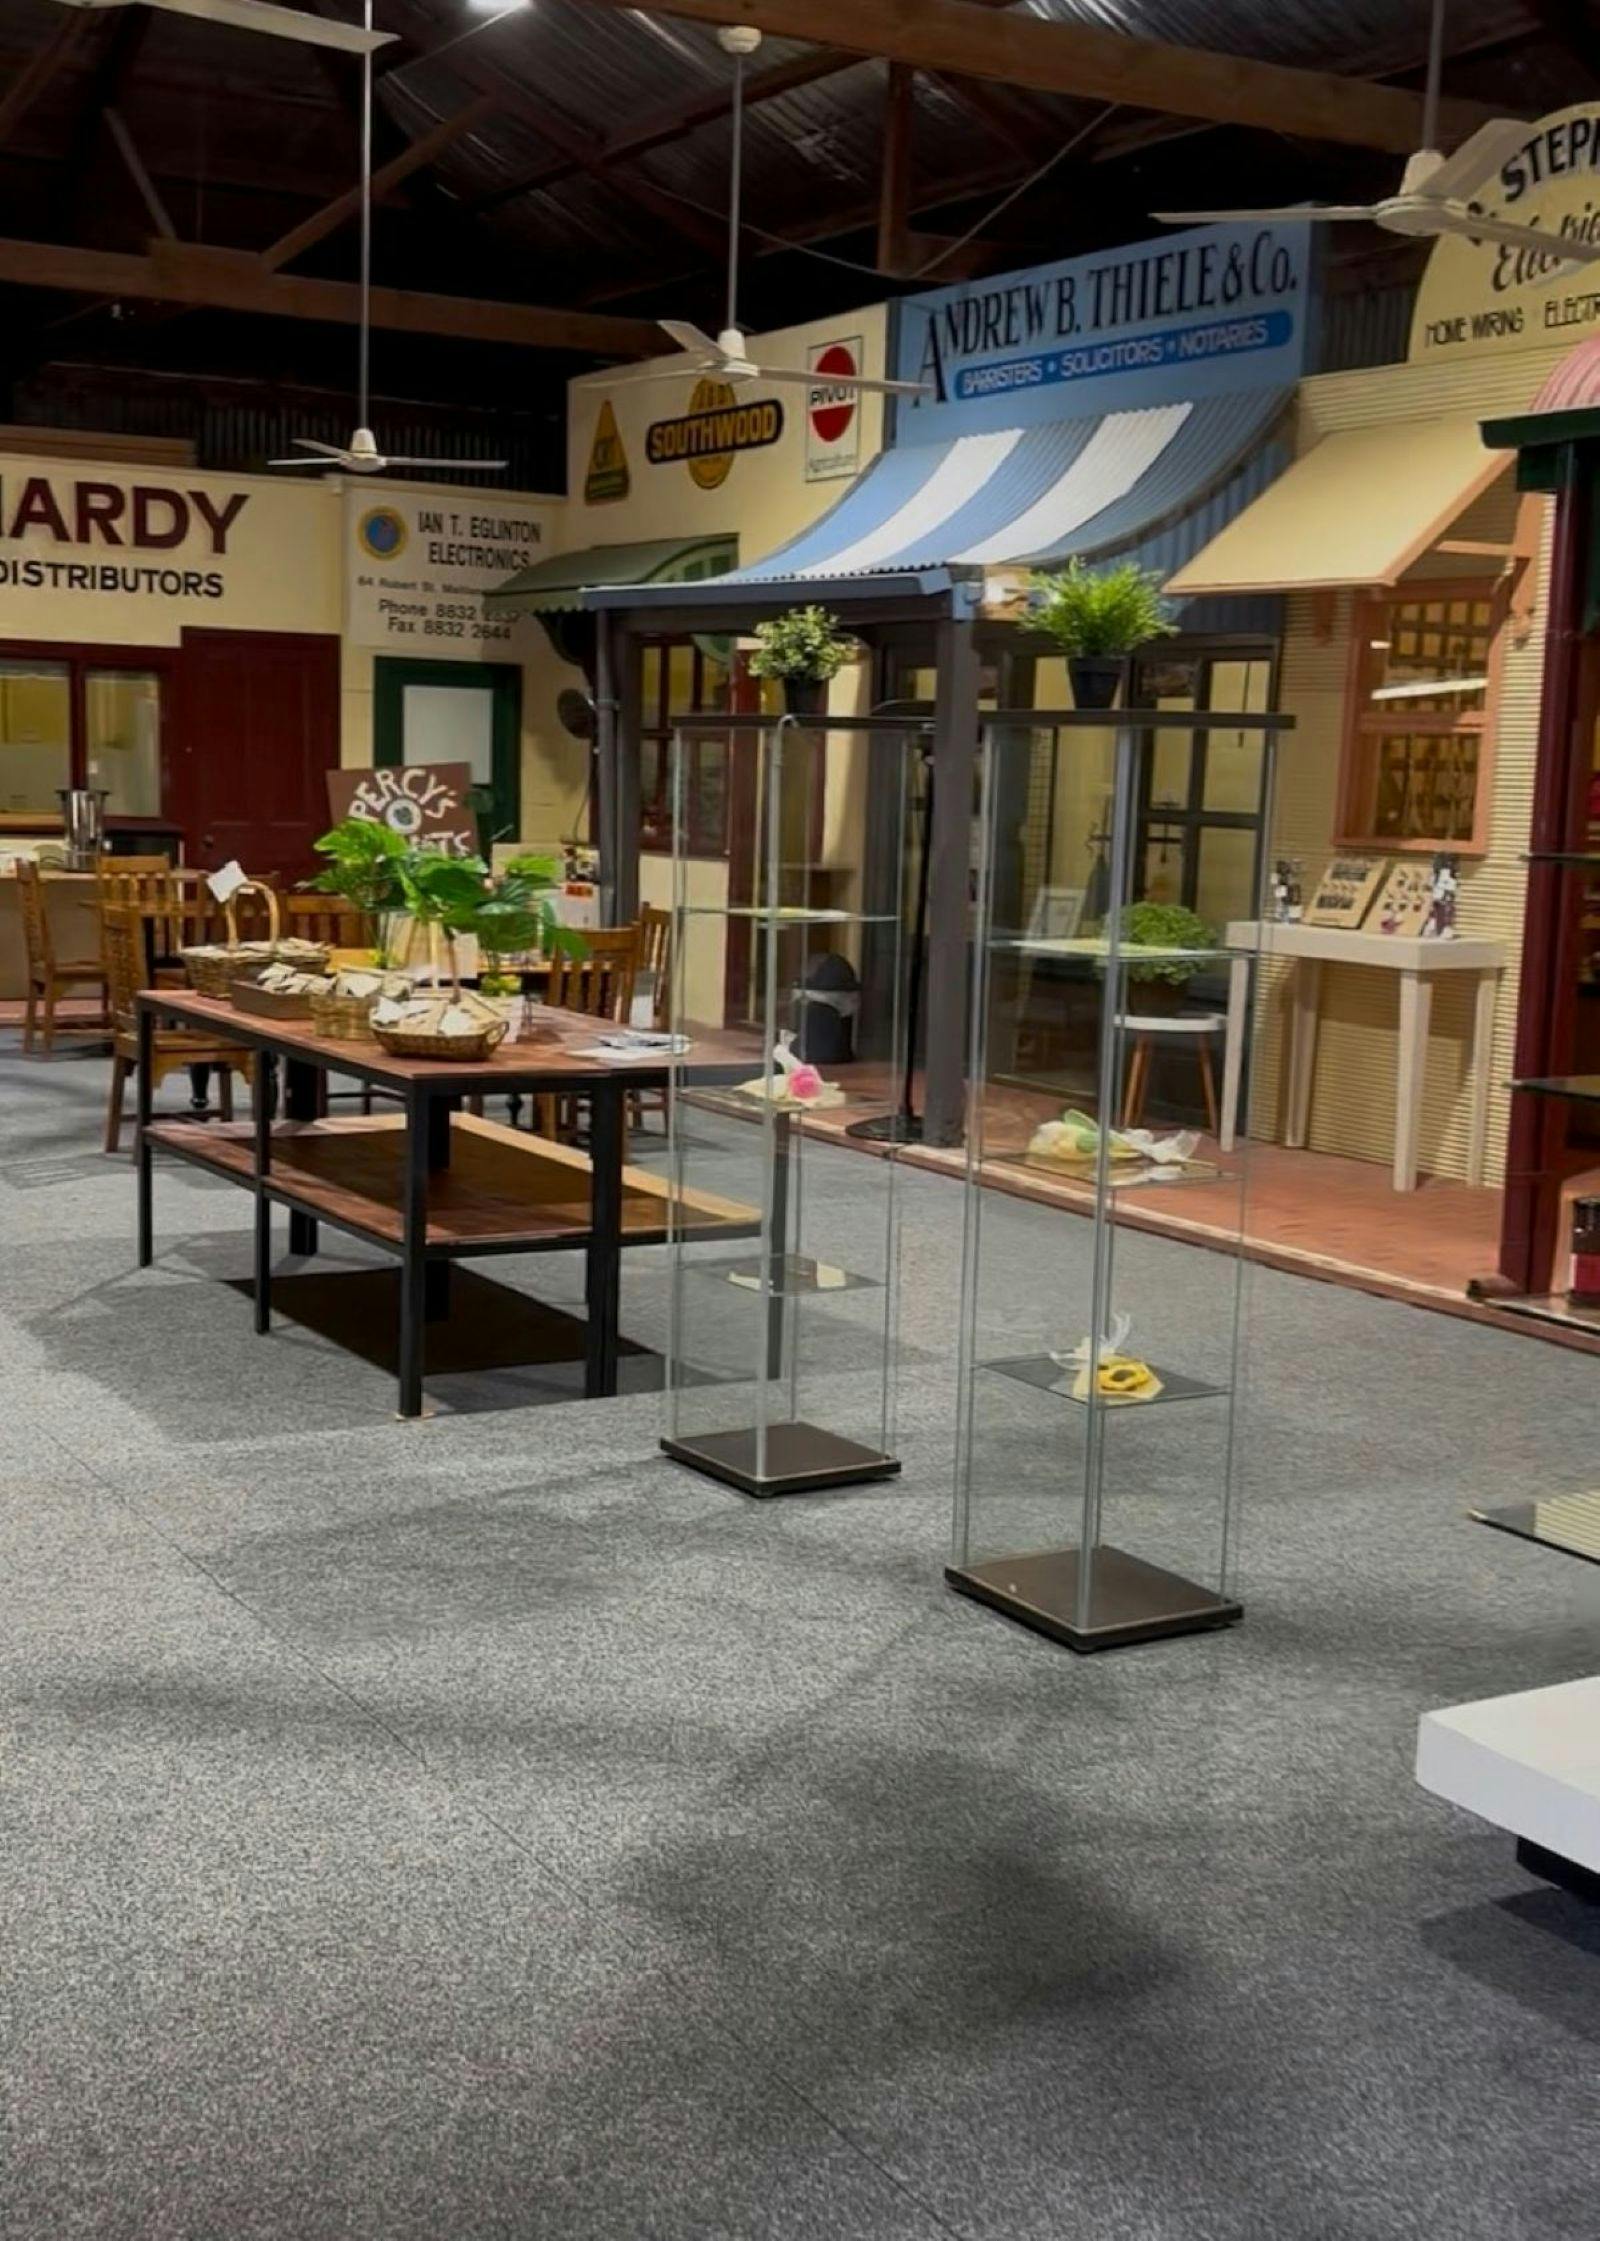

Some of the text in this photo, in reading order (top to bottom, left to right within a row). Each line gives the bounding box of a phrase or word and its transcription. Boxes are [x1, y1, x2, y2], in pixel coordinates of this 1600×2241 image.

[913, 280, 1050, 408] ANDREW
[1057, 276, 1081, 335] B.
[1088, 243, 1216, 329] THIELE
[963, 320, 1268, 395] BARRISTERS SOLICITORS NOTARIES
[652, 406, 776, 459] SOUTHWOOD
[0, 474, 250, 554] ARDY
[418, 511, 541, 543] IAN T. EGLINTON
[428, 542, 530, 570] ELECTRONICS
[379, 599, 428, 617] Phone
[388, 616, 416, 633] Fax
[348, 768, 458, 823] PERCY'S
